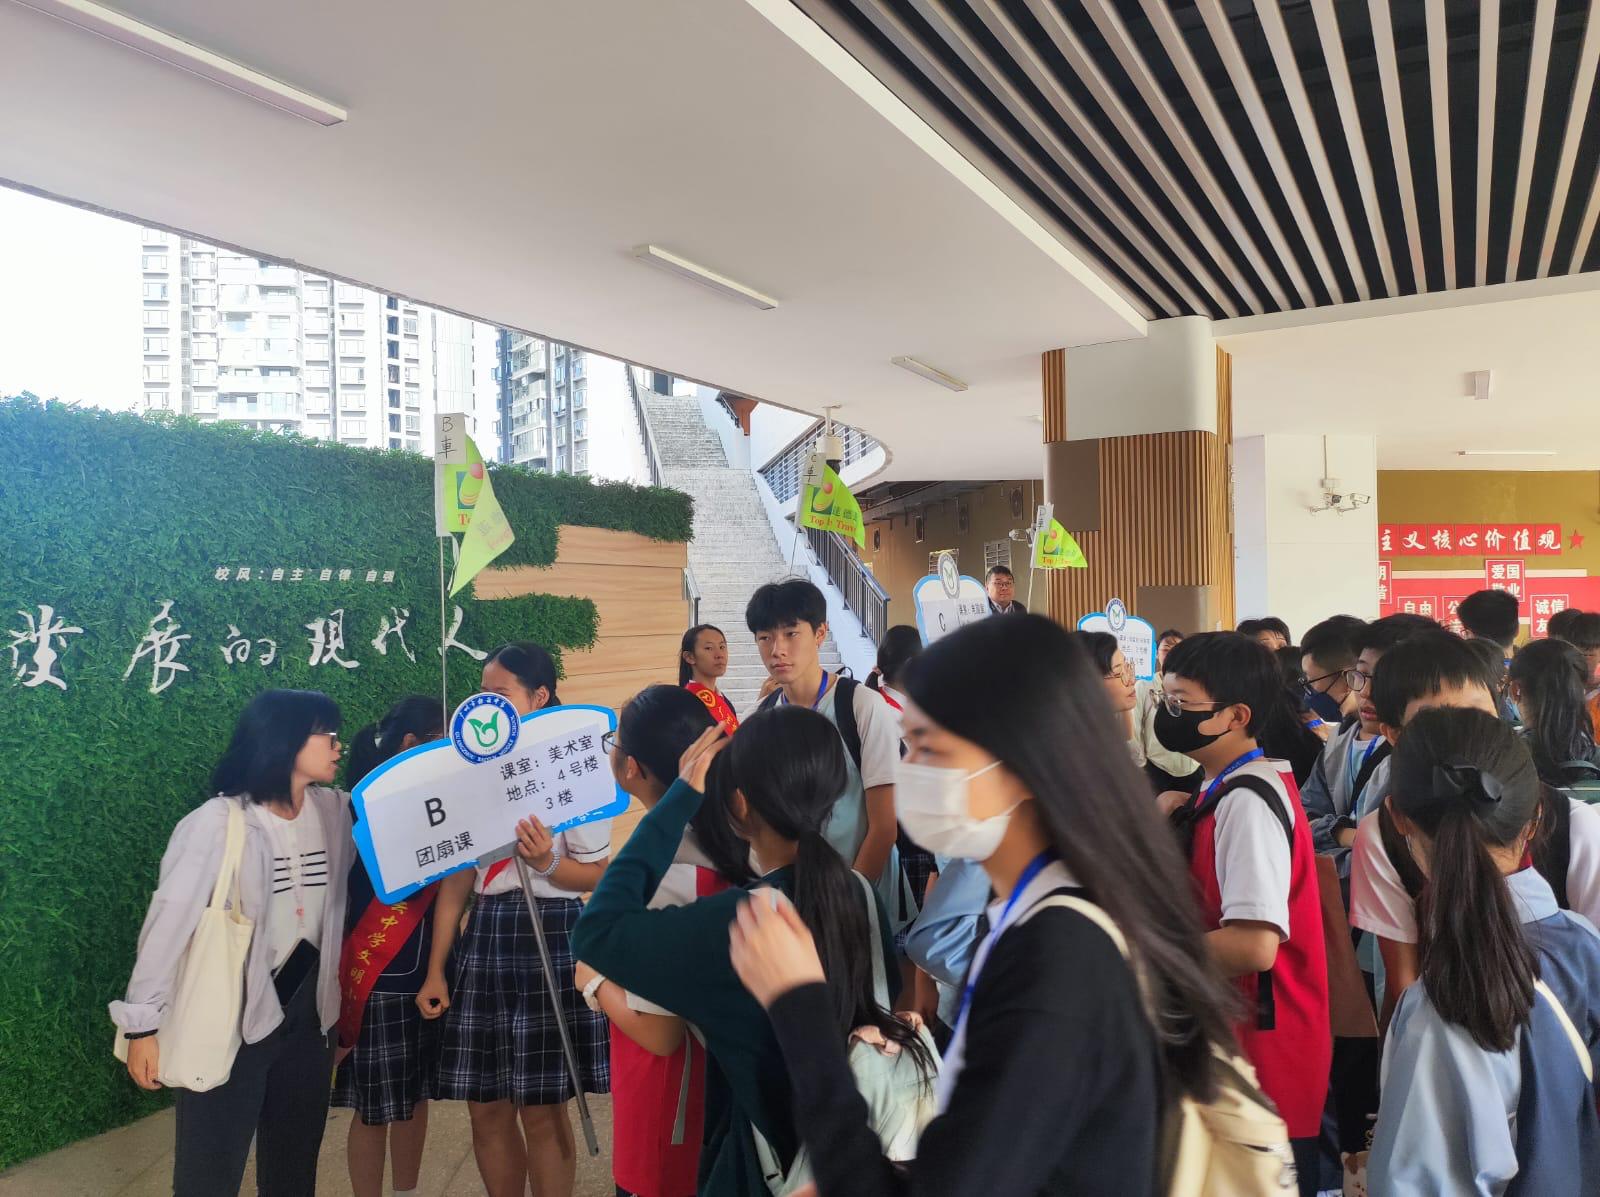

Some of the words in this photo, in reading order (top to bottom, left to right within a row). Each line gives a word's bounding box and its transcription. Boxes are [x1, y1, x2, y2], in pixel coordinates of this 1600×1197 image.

[1381, 528, 1561, 551] 主义核心价值观
[1491, 564, 1520, 579] 爱国
[1404, 600, 1432, 615] 自由
[1535, 599, 1565, 615] 诚信
[424, 797, 447, 828] B
[415, 831, 475, 868] 团扇课
